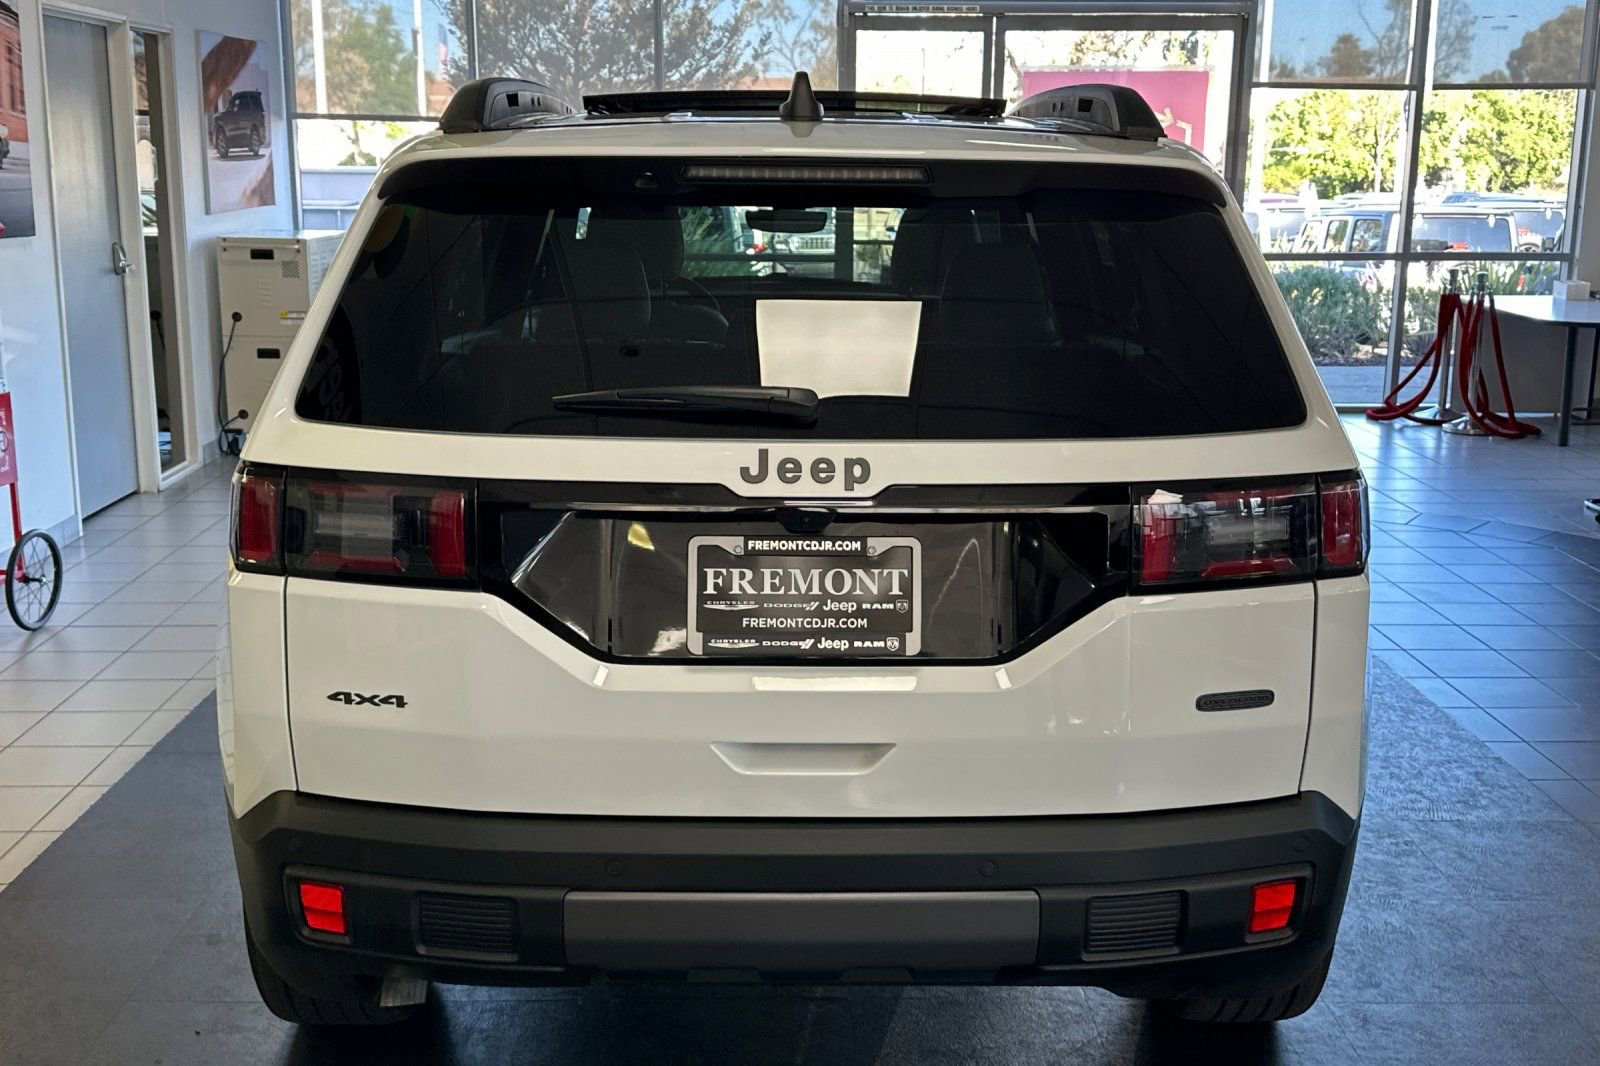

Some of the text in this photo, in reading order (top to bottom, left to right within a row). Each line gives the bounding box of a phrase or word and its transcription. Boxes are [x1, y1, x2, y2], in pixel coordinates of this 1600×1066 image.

[740, 448, 871, 491] Jeep
[748, 540, 861, 551] FREMONTCDJR.COM
[703, 568, 909, 595] FREMONT
[823, 599, 857, 613] Jeep
[742, 617, 868, 628] FREMONTCDJR.COM
[817, 637, 849, 651] Jeep
